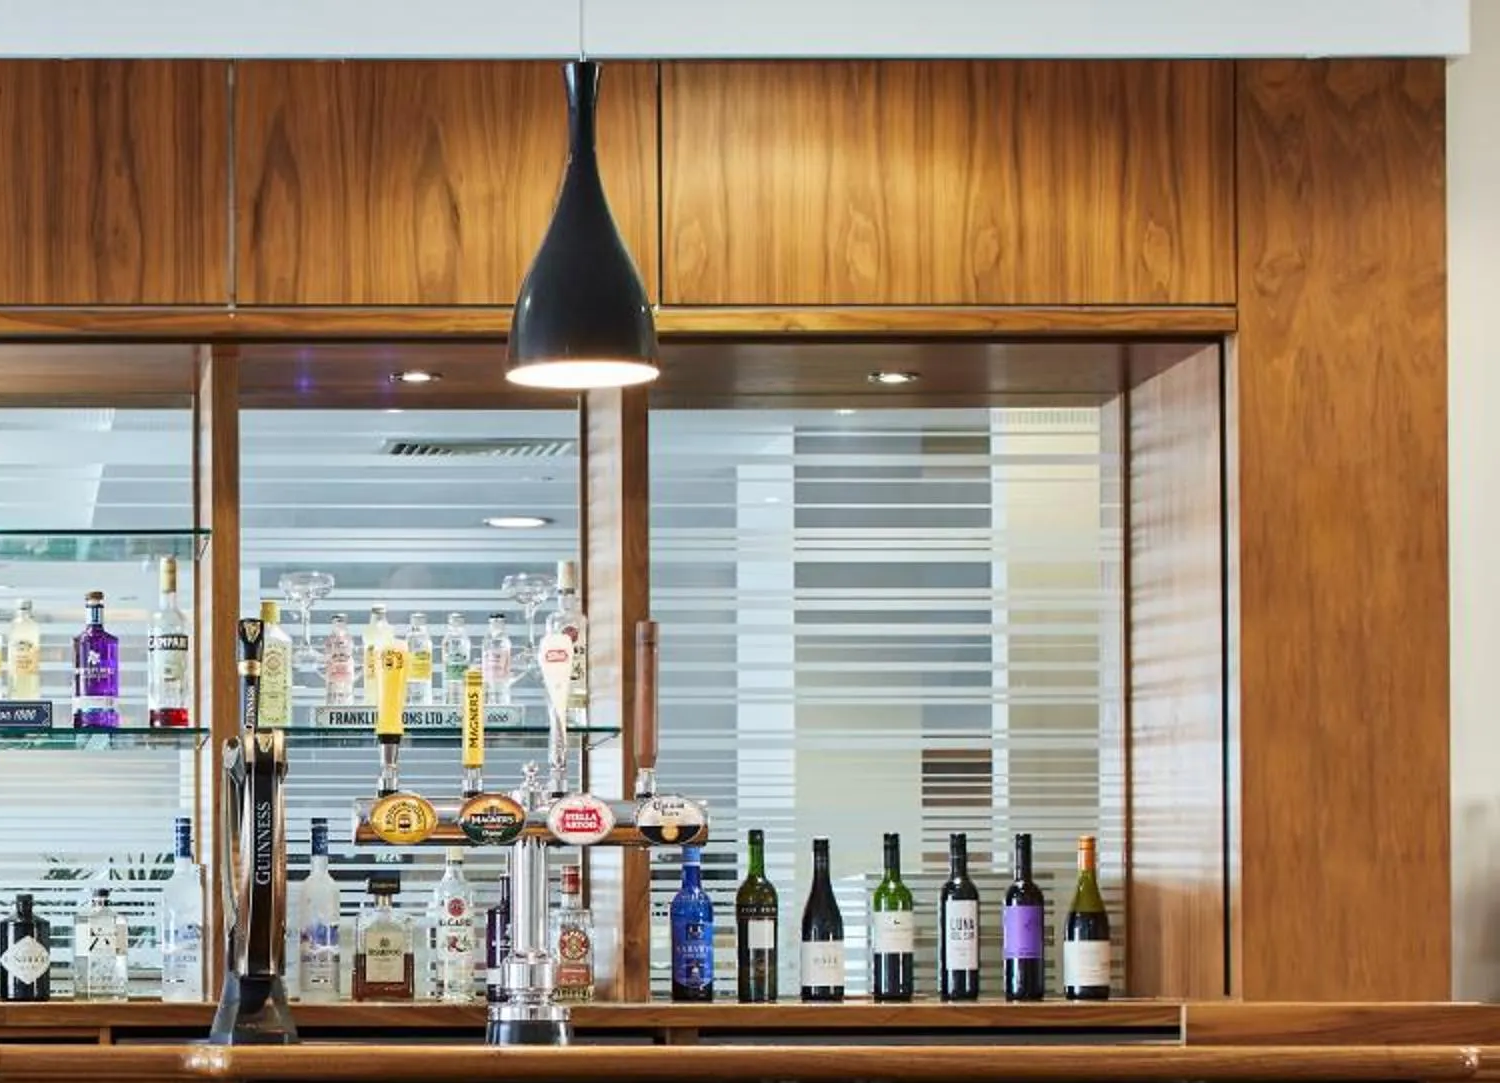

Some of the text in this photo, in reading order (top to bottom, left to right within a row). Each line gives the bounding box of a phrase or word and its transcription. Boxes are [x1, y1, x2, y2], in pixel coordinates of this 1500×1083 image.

[425, 711, 443, 725] LTD
[468, 691, 479, 749] MAGNERS
[564, 813, 597, 821] STELLA
[255, 800, 272, 886] GUINNESS
